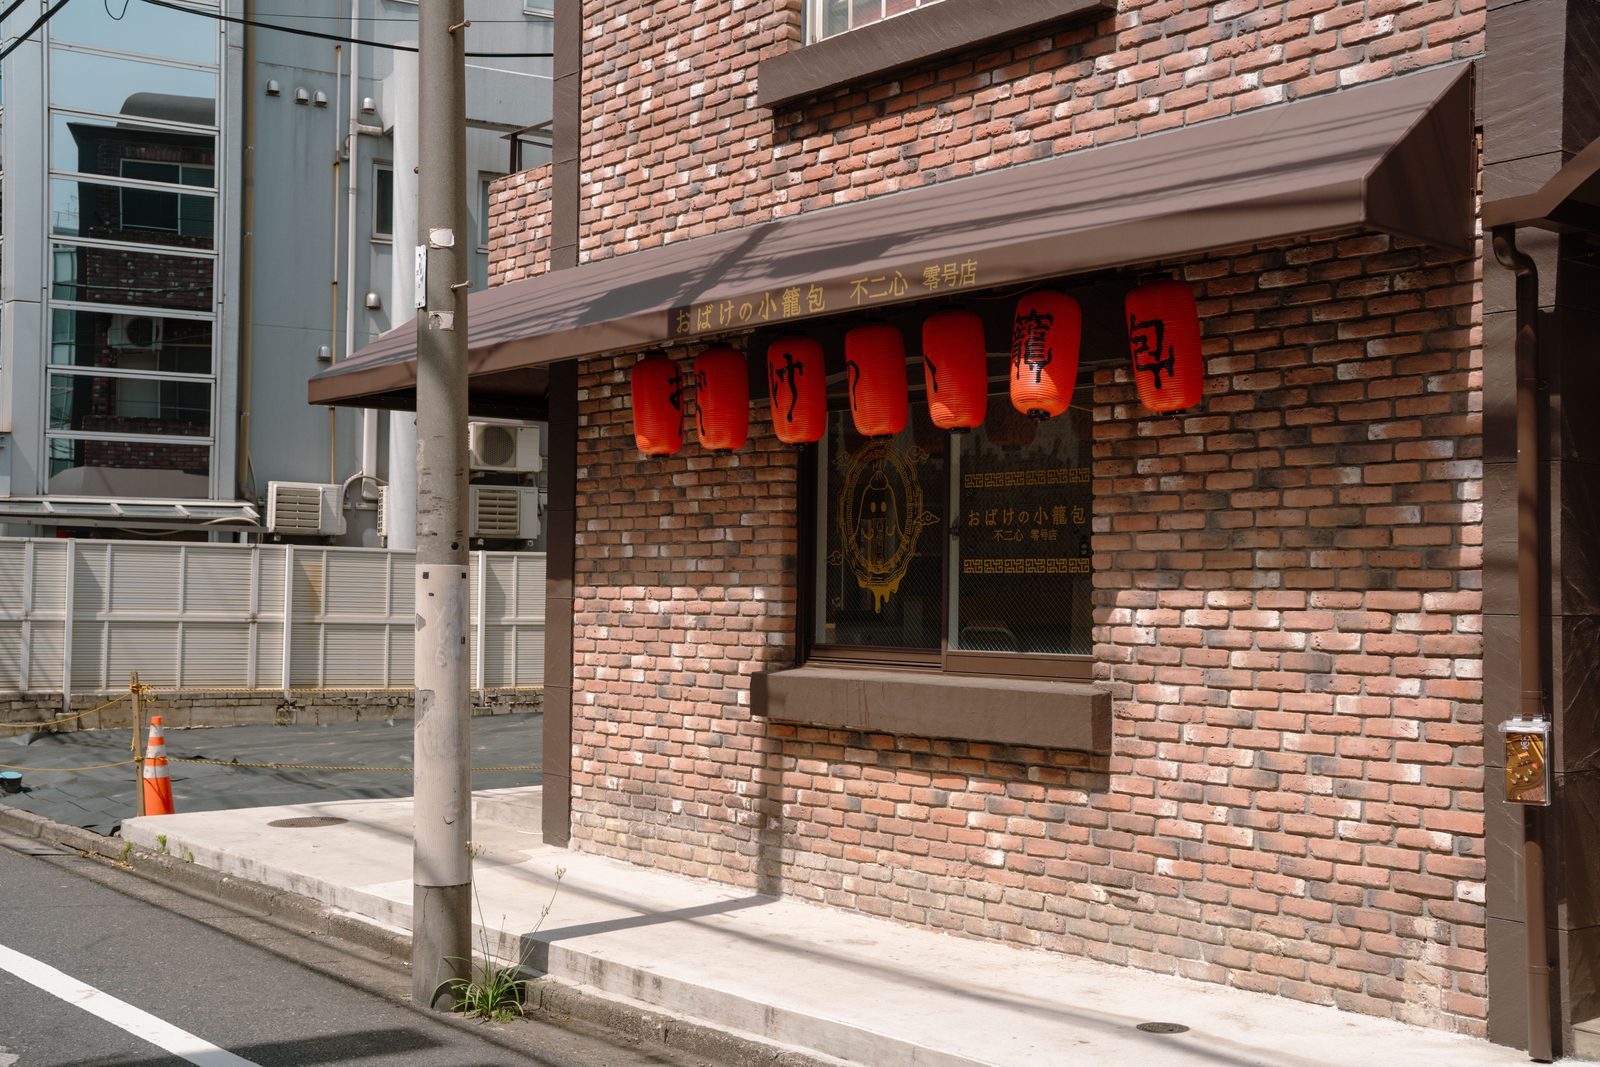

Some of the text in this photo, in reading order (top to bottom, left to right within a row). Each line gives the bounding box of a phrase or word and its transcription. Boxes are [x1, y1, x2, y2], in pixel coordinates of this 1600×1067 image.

[676, 259, 978, 333] おばけの小籠包 不二心 零号店
[968, 504, 1086, 527] おばけの小籠包
[993, 528, 1024, 542] 不二心
